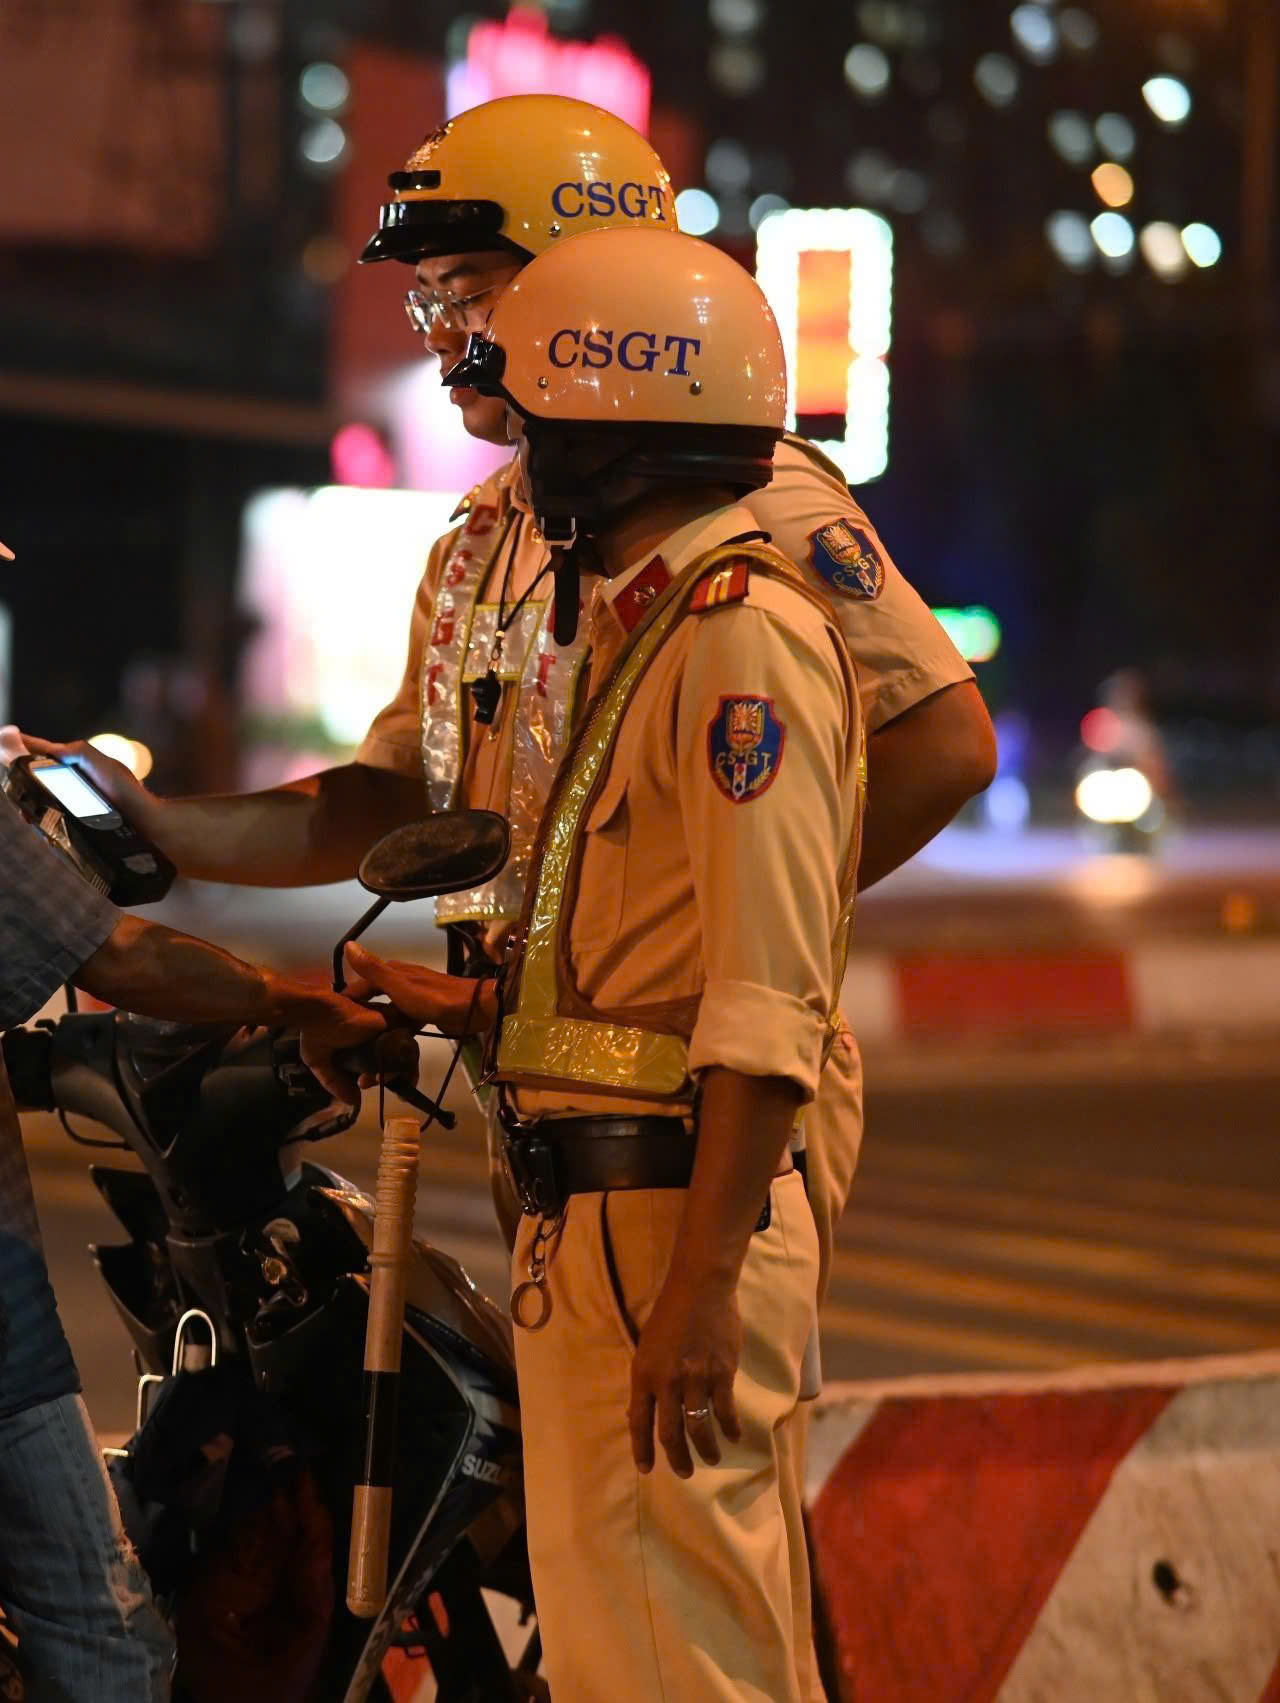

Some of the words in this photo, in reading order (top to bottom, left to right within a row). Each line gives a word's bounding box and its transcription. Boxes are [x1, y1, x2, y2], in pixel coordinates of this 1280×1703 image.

[551, 182, 667, 222] CSGT
[548, 329, 701, 377] CSGT
[832, 552, 876, 584] CSGT
[715, 750, 773, 767] CSGT
